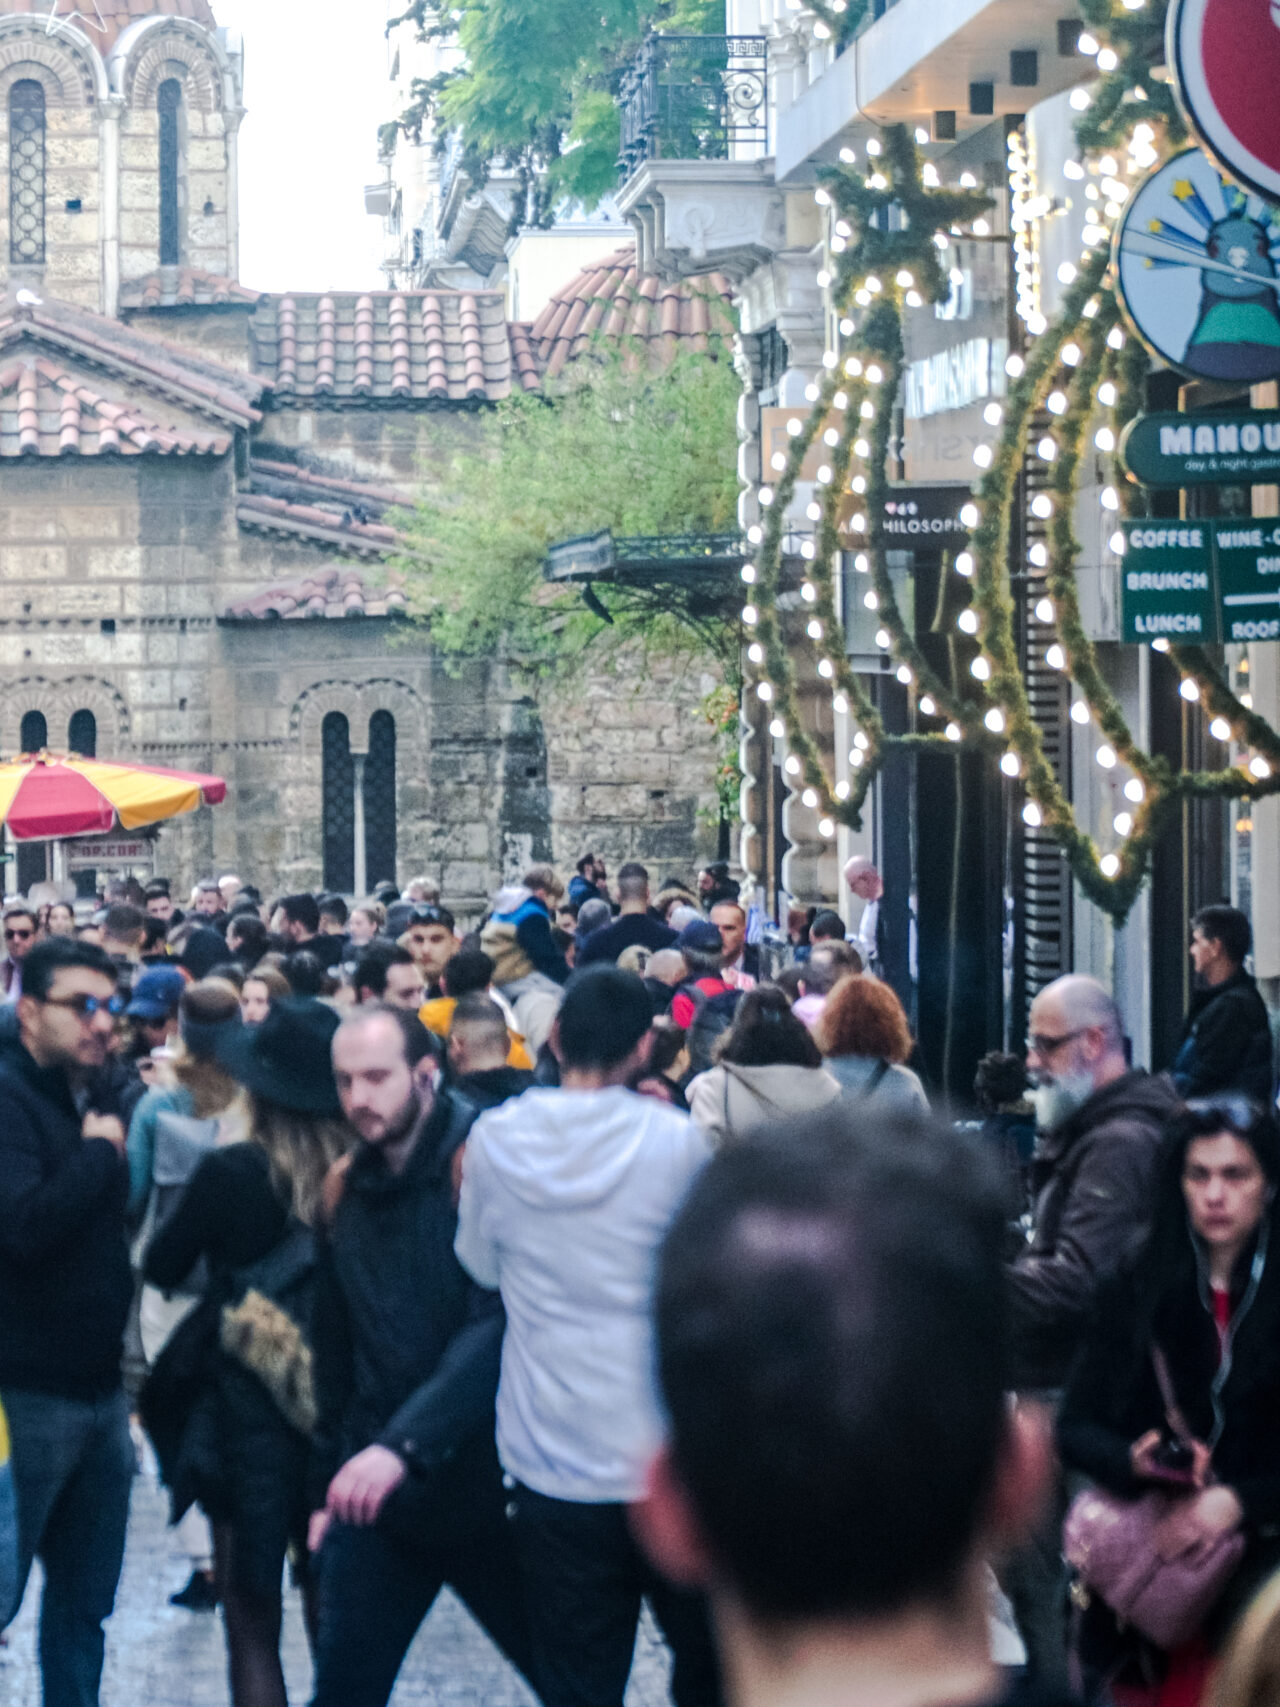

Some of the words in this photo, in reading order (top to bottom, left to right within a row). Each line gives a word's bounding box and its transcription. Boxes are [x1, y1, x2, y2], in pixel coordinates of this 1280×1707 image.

[1185, 459, 1204, 472] day
[1220, 457, 1247, 474] night
[1130, 530, 1202, 548] COFFEE
[1127, 572, 1208, 590] BRUNCH
[1135, 615, 1202, 633] LUNCH
